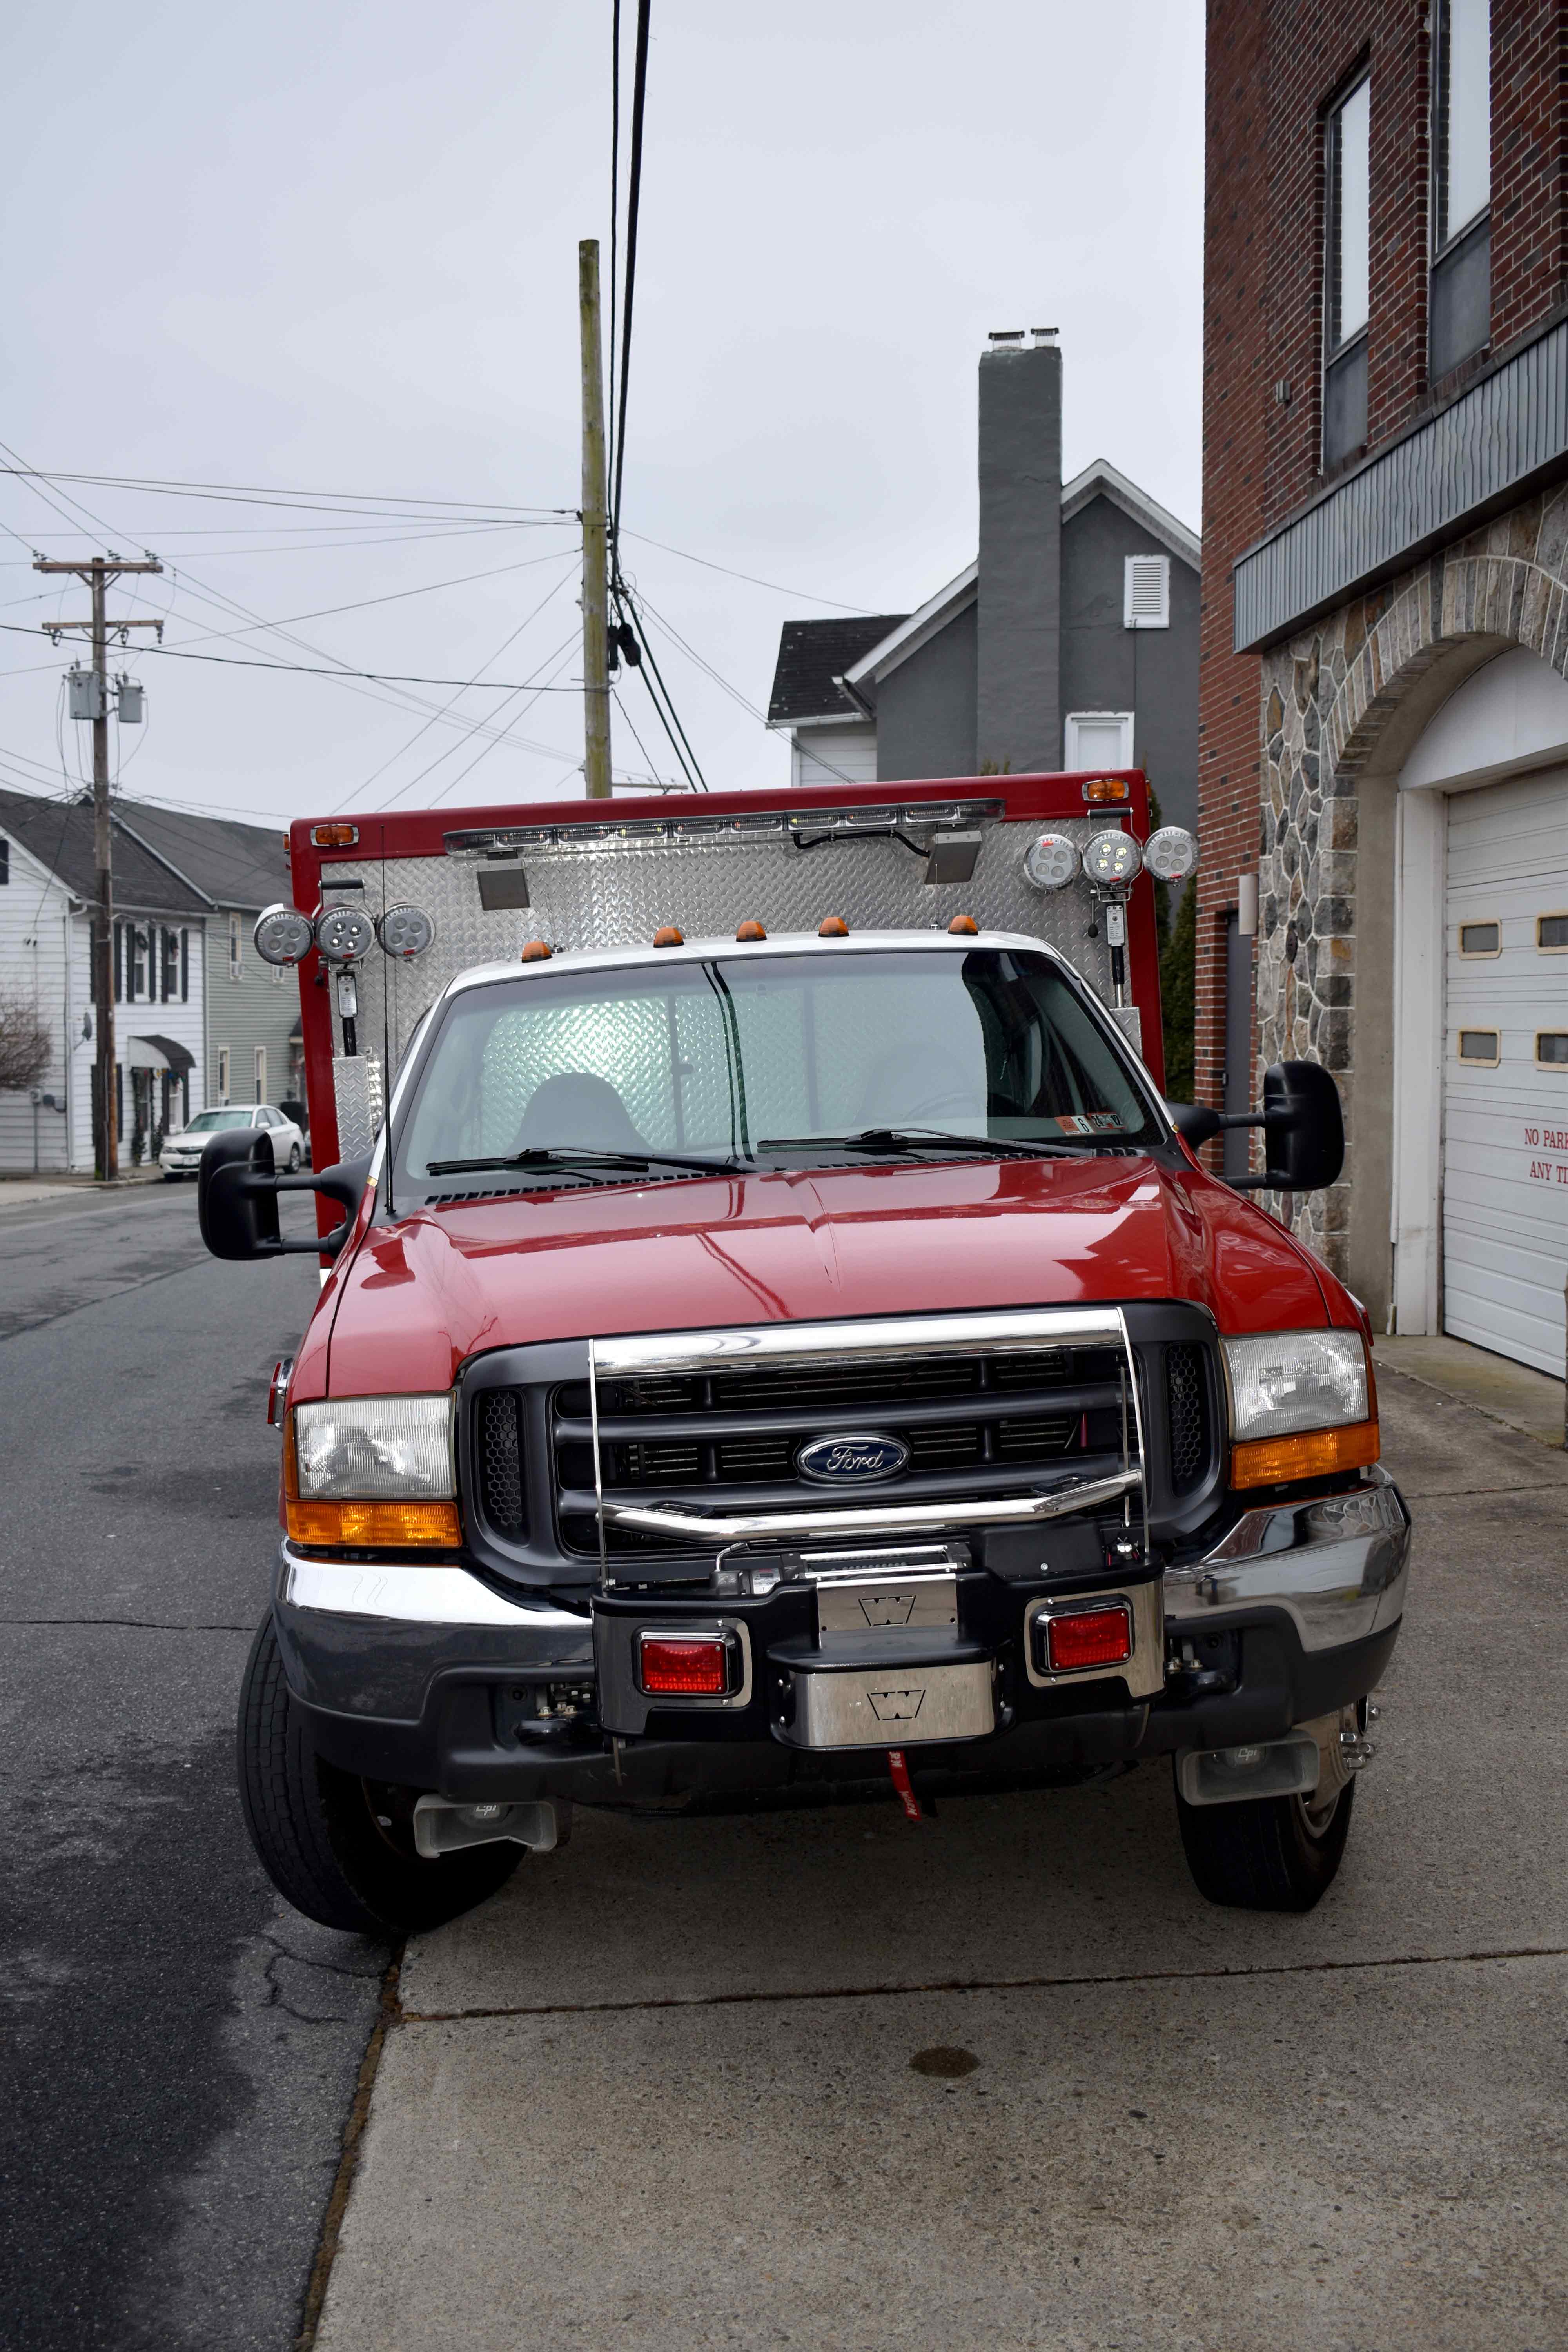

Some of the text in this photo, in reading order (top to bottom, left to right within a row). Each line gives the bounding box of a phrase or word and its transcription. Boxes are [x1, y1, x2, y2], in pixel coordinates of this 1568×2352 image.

[1078, 1118, 1090, 1132] 6
[1524, 1128, 1539, 1145] NO
[1530, 1161, 1552, 1181] ANY
[827, 1446, 884, 1471] Ford
